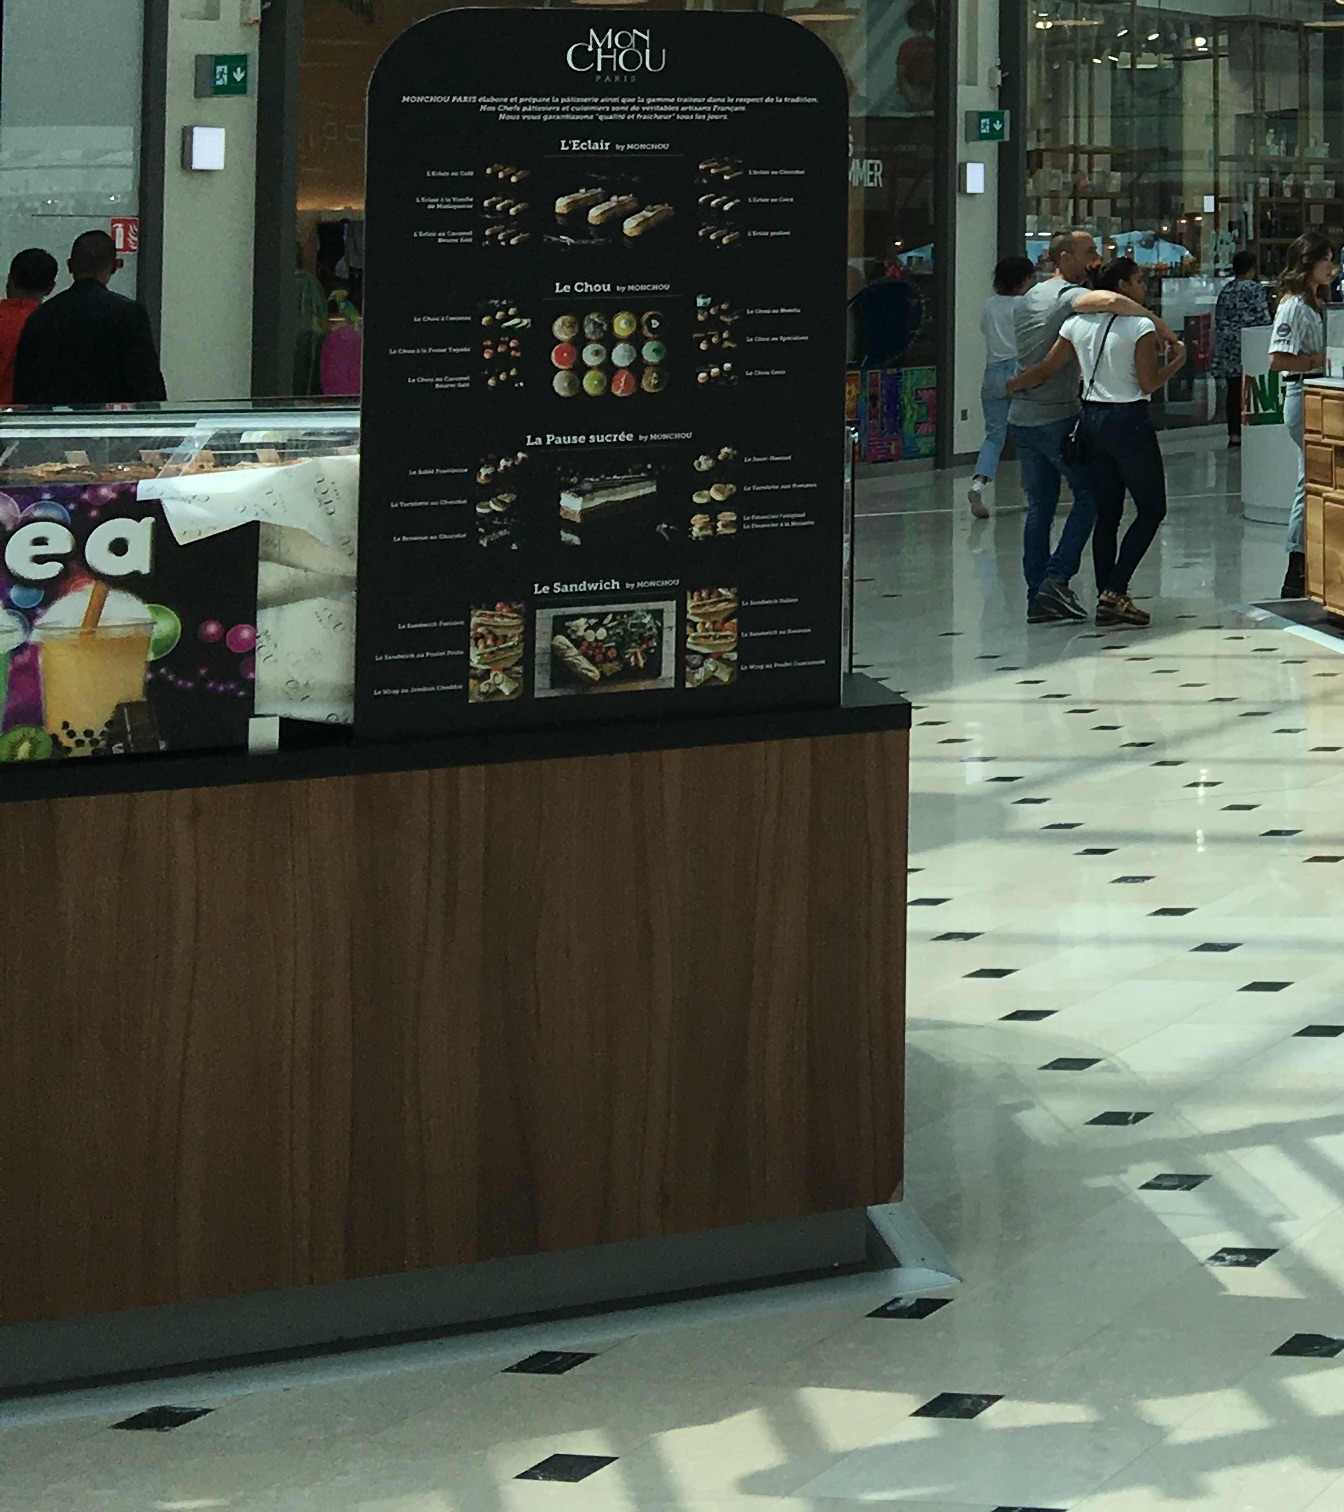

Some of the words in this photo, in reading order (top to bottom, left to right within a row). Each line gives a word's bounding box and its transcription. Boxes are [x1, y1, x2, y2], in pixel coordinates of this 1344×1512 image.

[589, 28, 650, 49] MON
[566, 42, 666, 72] CHOU
[595, 75, 637, 83] PARIS
[560, 139, 611, 151] L'Eclair
[615, 143, 625, 151] by
[554, 282, 571, 293] Le
[573, 281, 611, 293] Chou
[616, 285, 626, 293] by
[525, 434, 543, 446] La
[545, 433, 586, 445] Pause
[588, 431, 634, 444] sucrée
[638, 434, 649, 442] by
[649, 432, 693, 441] MONCHOU
[533, 583, 550, 595] Le
[552, 579, 621, 594] Sandwich
[625, 582, 636, 590] by
[636, 578, 680, 589] MONCHOU
